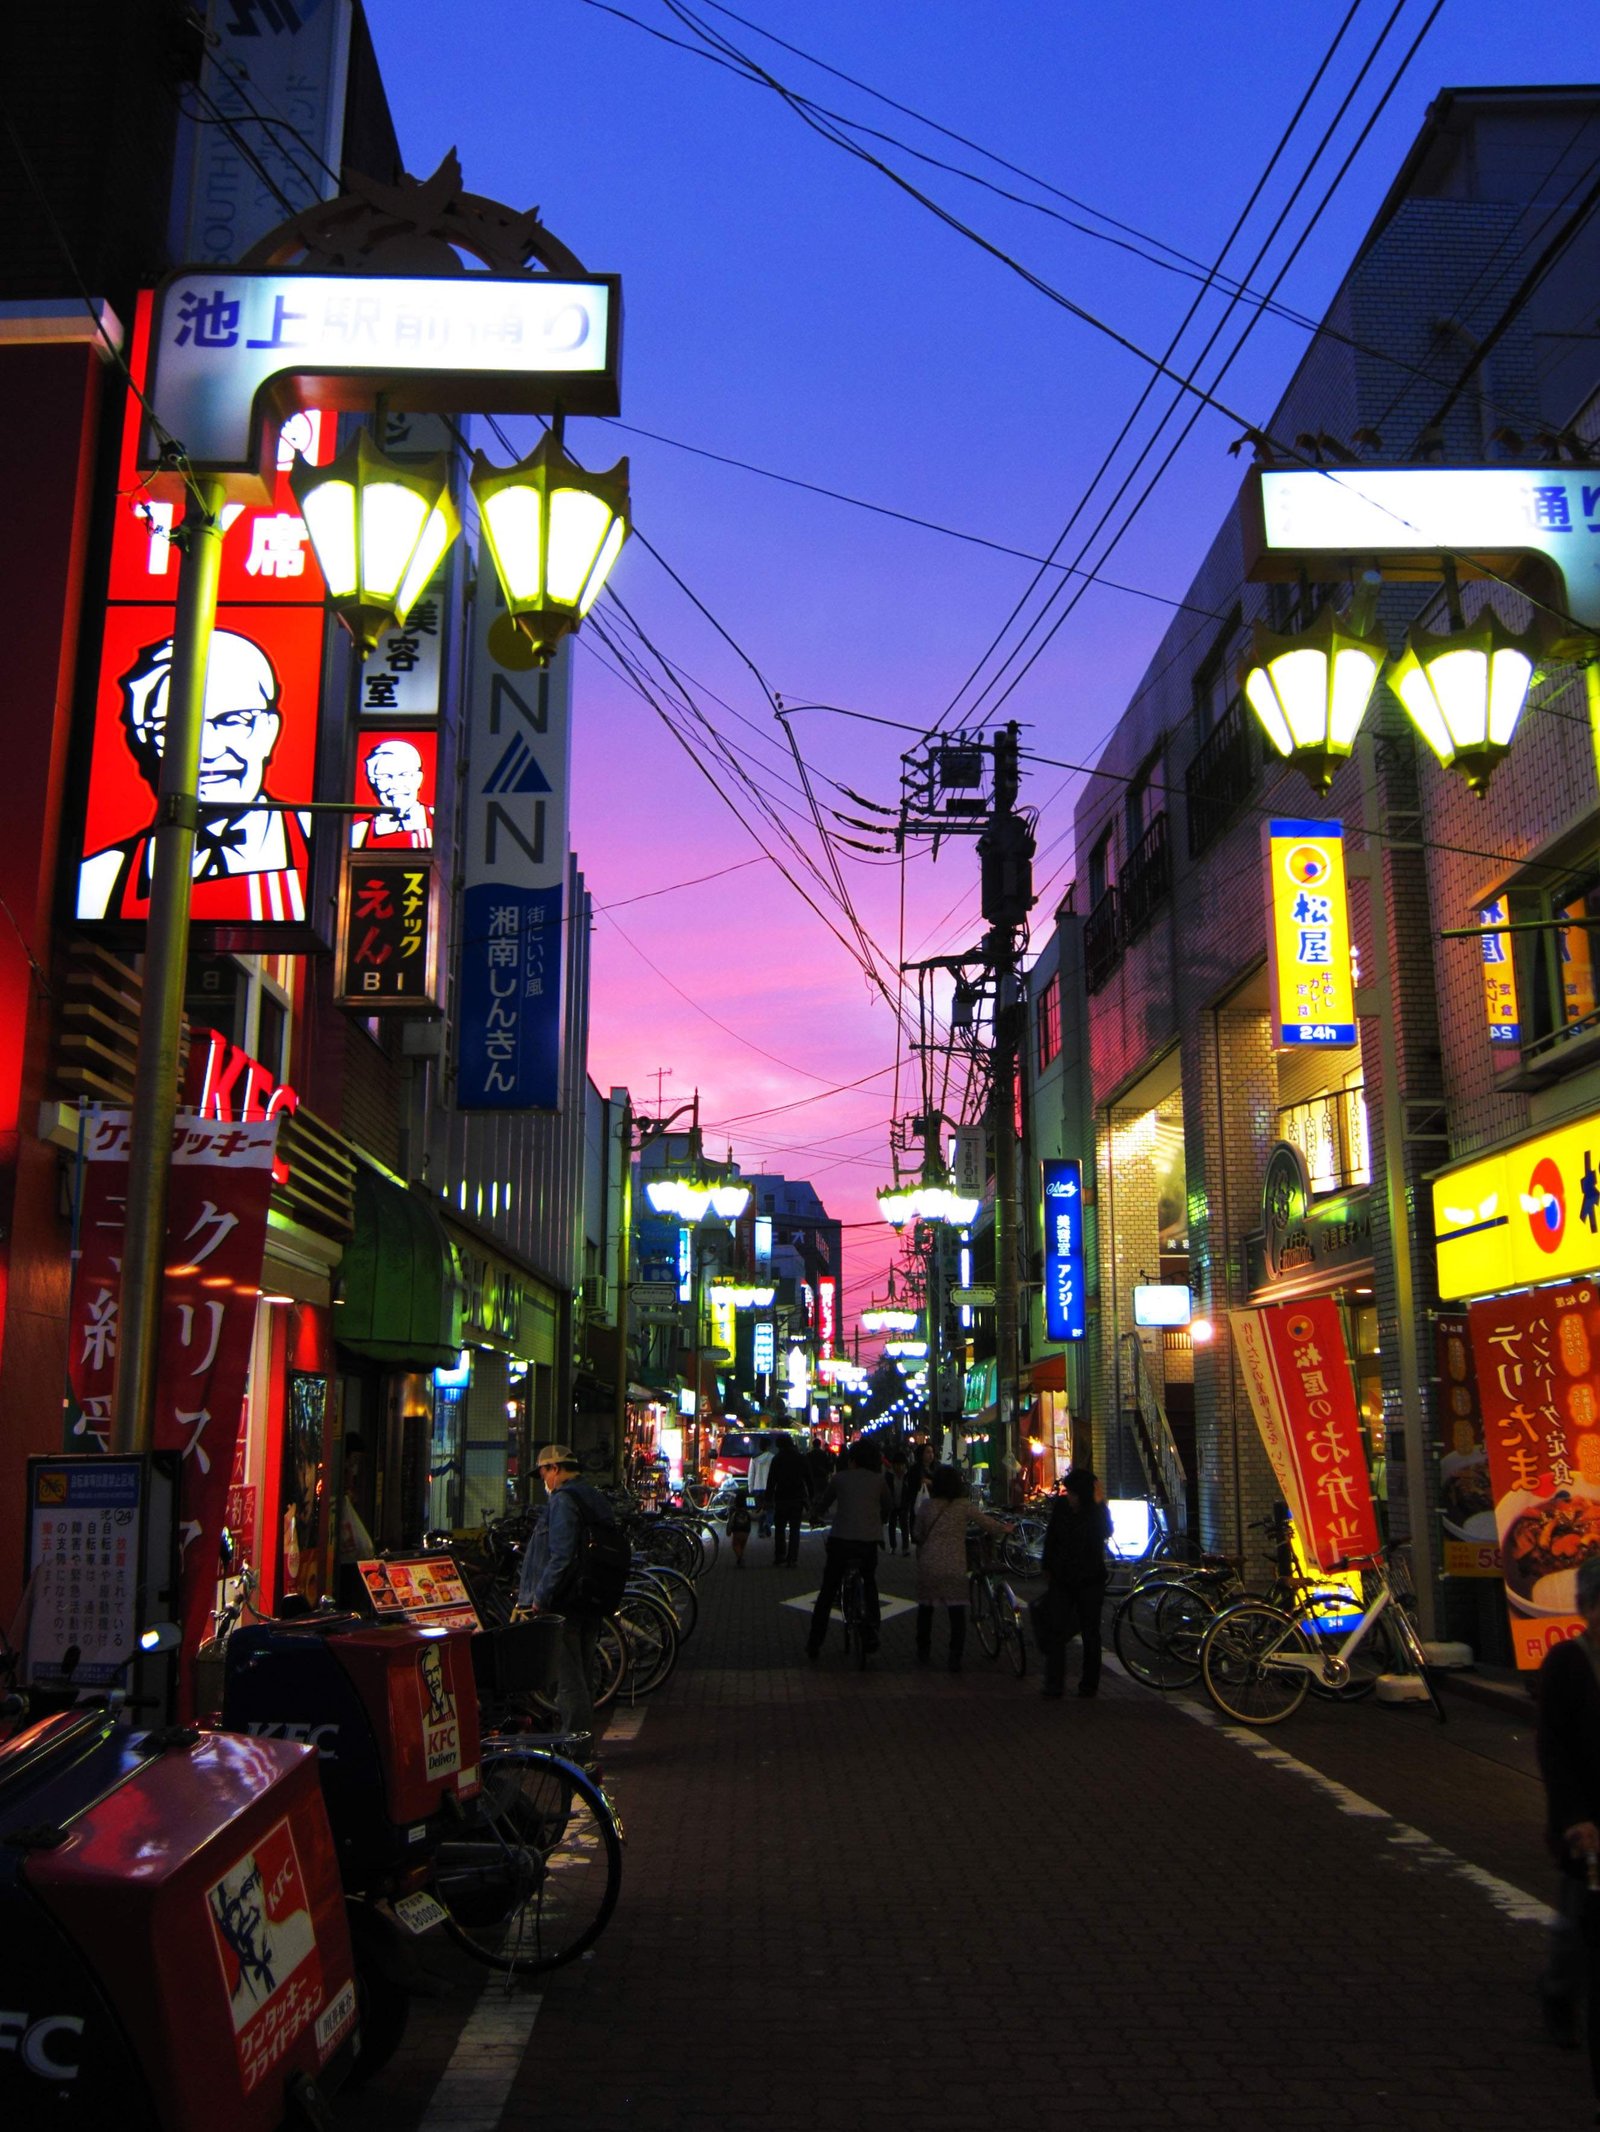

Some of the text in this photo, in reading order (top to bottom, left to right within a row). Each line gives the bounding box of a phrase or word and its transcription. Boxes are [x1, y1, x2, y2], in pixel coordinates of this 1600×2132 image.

[354, 879, 394, 966] えん
[400, 872, 424, 959] スナック
[525, 904, 547, 998] 街にいい風
[1292, 892, 1331, 964] 松屋
[484, 905, 519, 1092] 湘南しんきん
[1298, 1025, 1337, 1041] 24h
[1309, 977, 1321, 1014] カレー
[1057, 1263, 1074, 1322] アンジー
[113, 1536, 127, 1648] 放置されている
[427, 1726, 457, 1756] KFC
[428, 1750, 457, 1771] Delivery
[266, 1856, 294, 1914] KFC
[240, 1976, 308, 2065] ケンタッキー
[244, 1982, 323, 2092] フライドチキン
